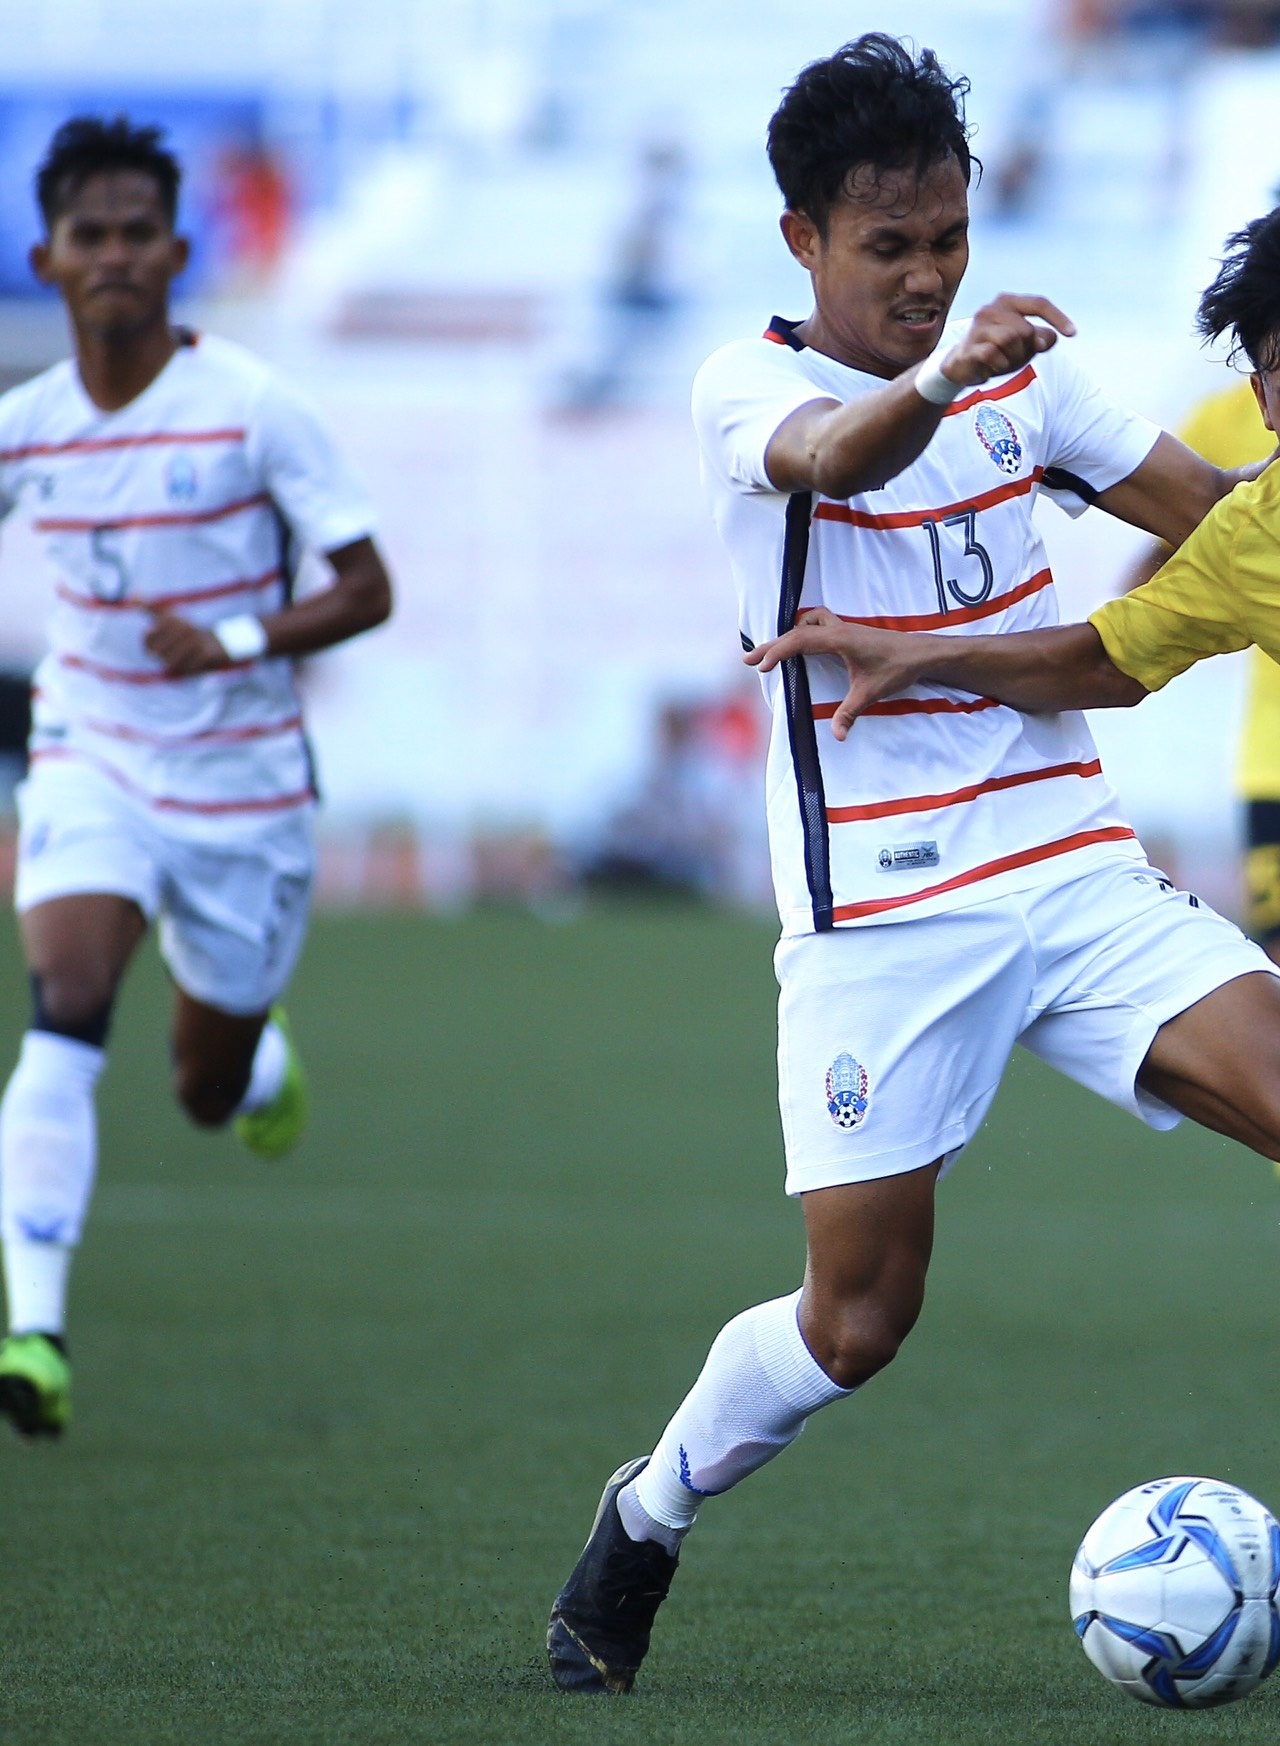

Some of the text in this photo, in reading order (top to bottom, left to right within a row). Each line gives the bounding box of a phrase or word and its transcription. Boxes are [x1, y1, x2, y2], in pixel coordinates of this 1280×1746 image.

[87, 522, 132, 606] 5
[922, 508, 994, 615] 13
[834, 1092, 860, 1106] FFC
